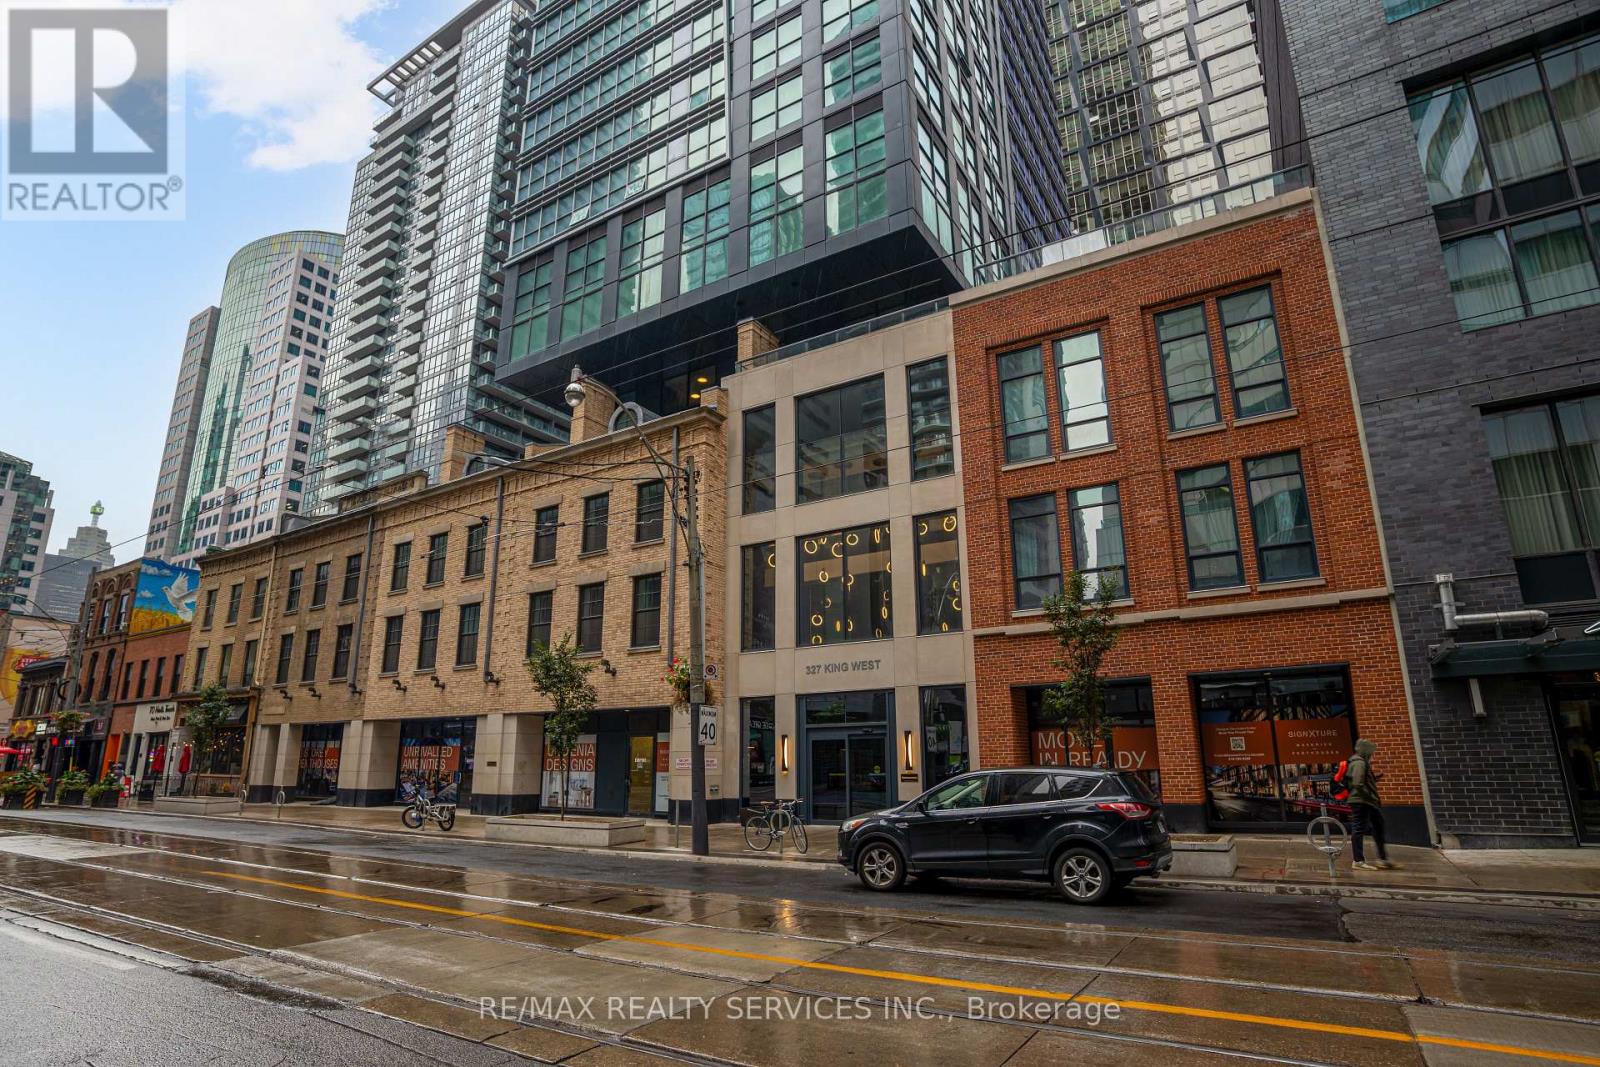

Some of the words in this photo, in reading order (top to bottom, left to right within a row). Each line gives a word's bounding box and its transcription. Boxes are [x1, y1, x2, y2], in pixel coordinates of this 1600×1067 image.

[805, 664, 822, 676] 327
[823, 662, 849, 674] KING
[850, 659, 882, 672] WEST
[700, 722, 716, 740] 40
